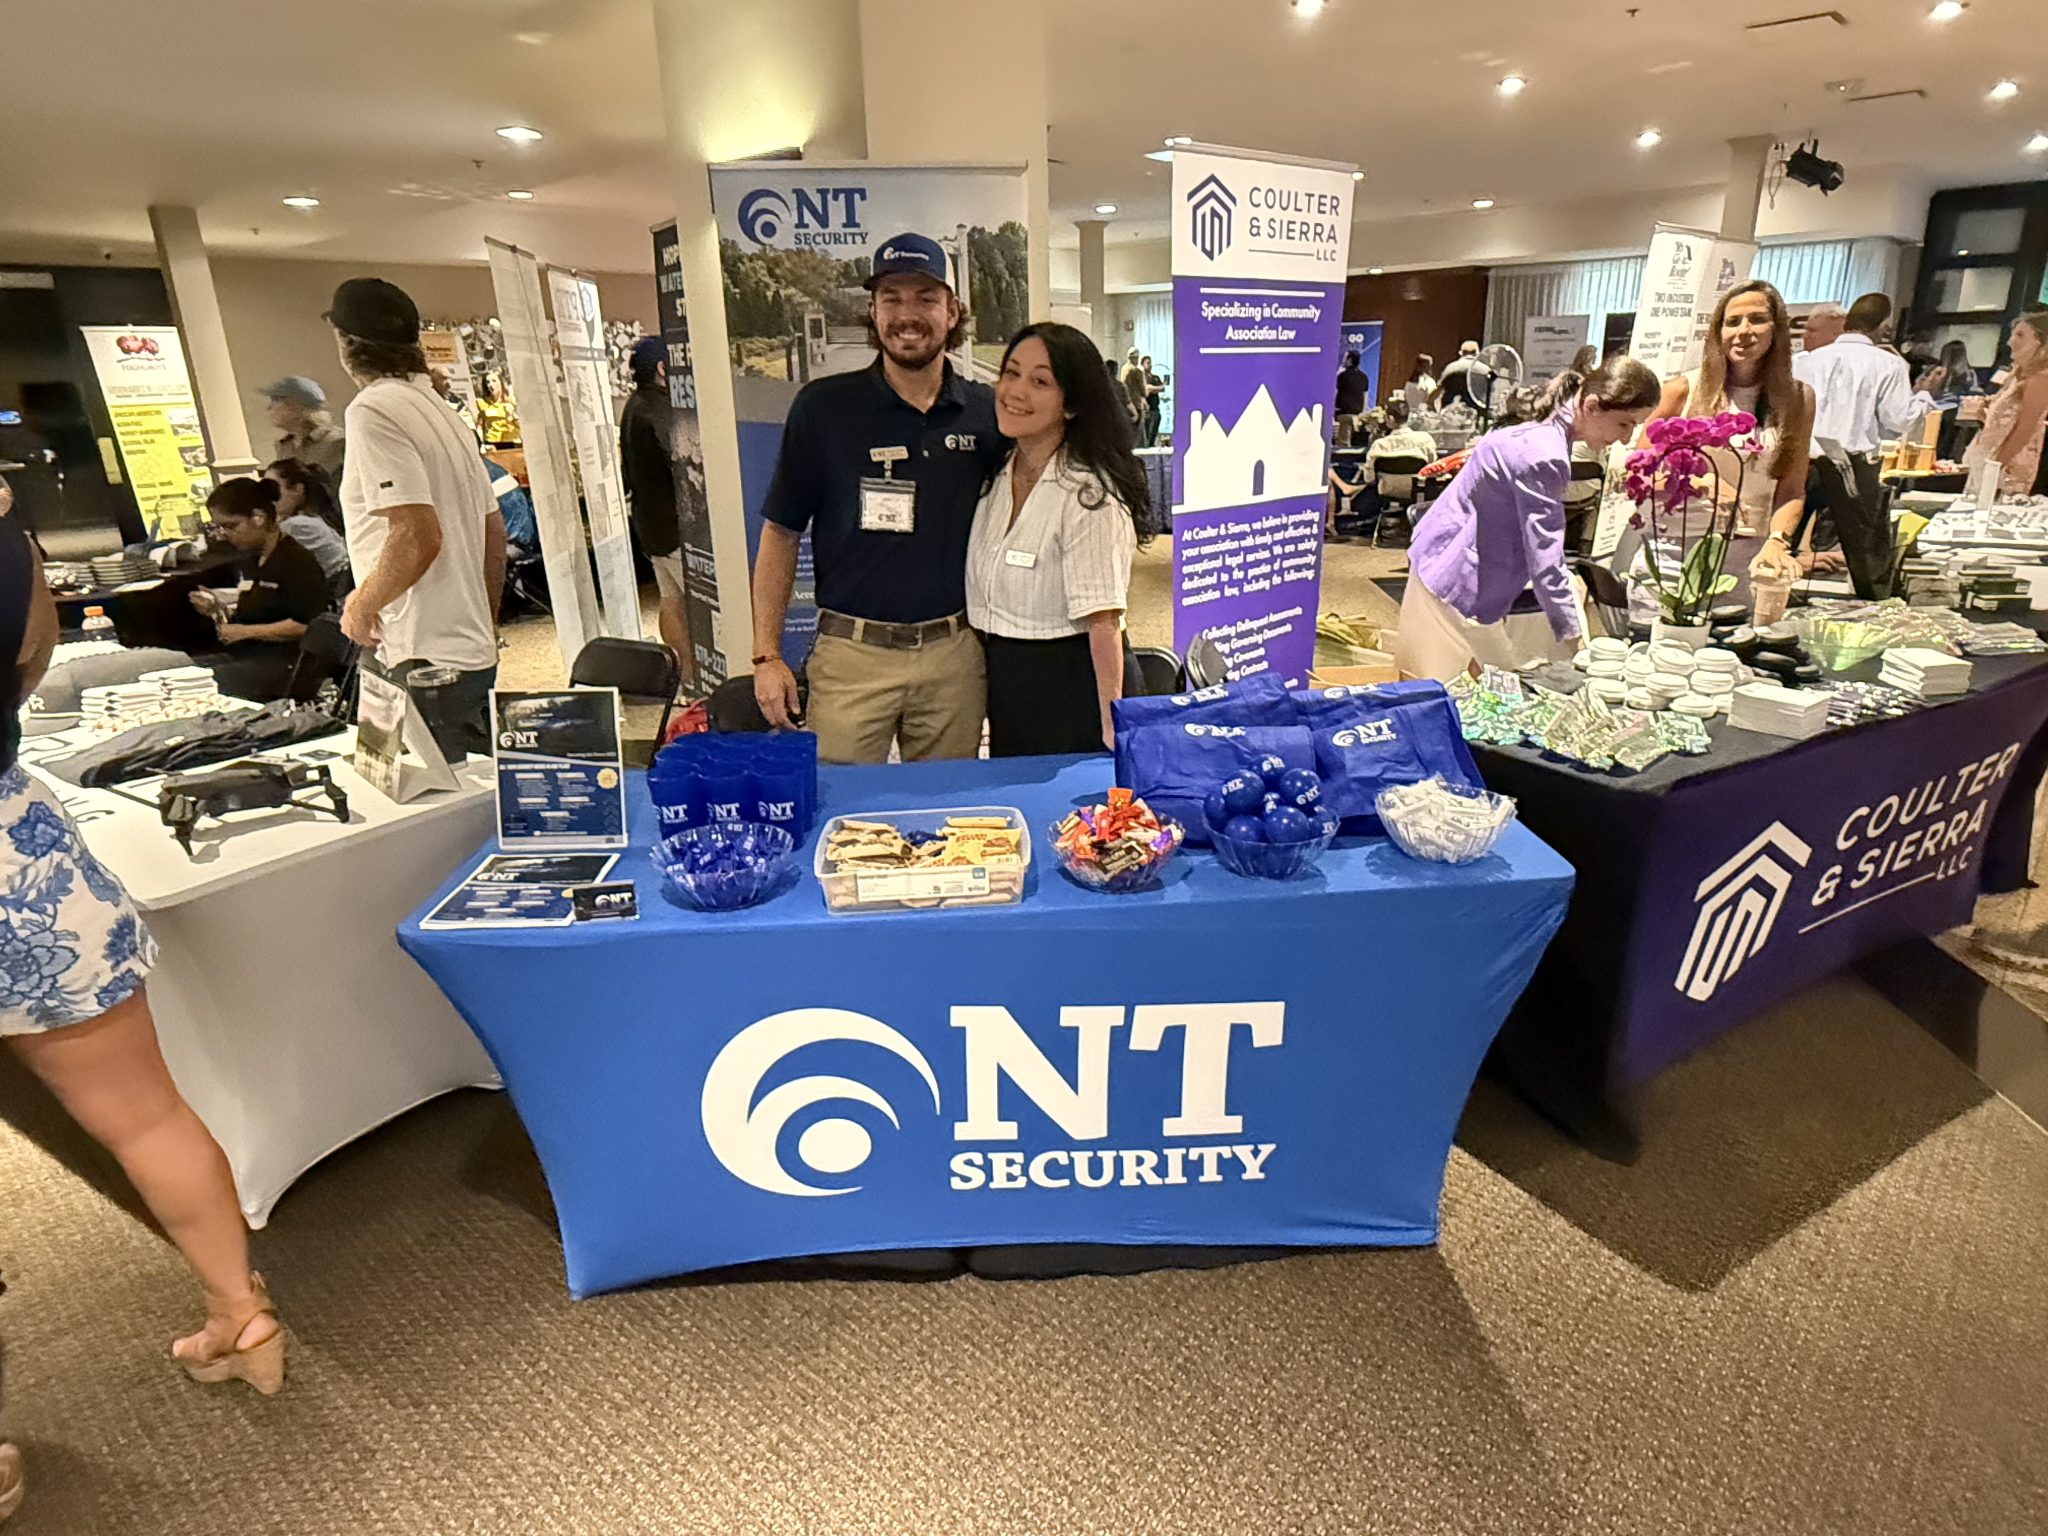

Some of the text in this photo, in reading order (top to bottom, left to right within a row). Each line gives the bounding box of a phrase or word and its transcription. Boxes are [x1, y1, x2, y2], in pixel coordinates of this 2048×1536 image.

[792, 187, 867, 229] NT
[1249, 186, 1340, 216] COULTER
[794, 231, 869, 245] SECURITY
[1249, 216, 1338, 244] & SIERRA
[1316, 248, 1337, 262] LLC
[1201, 300, 1321, 323] Specializing in Community
[1225, 324, 1296, 341] Association Law
[514, 731, 538, 744] NT
[1354, 719, 1392, 737] NT
[1836, 742, 2020, 851] COULTER
[661, 804, 688, 819] NT
[714, 803, 740, 817] NT
[769, 801, 795, 816] NT
[1812, 799, 1988, 906] & SIERRA
[1935, 847, 1972, 881] LLC
[609, 892, 632, 905] NT
[950, 1001, 1286, 1141] NT
[950, 1143, 1277, 1190] SECURITY
